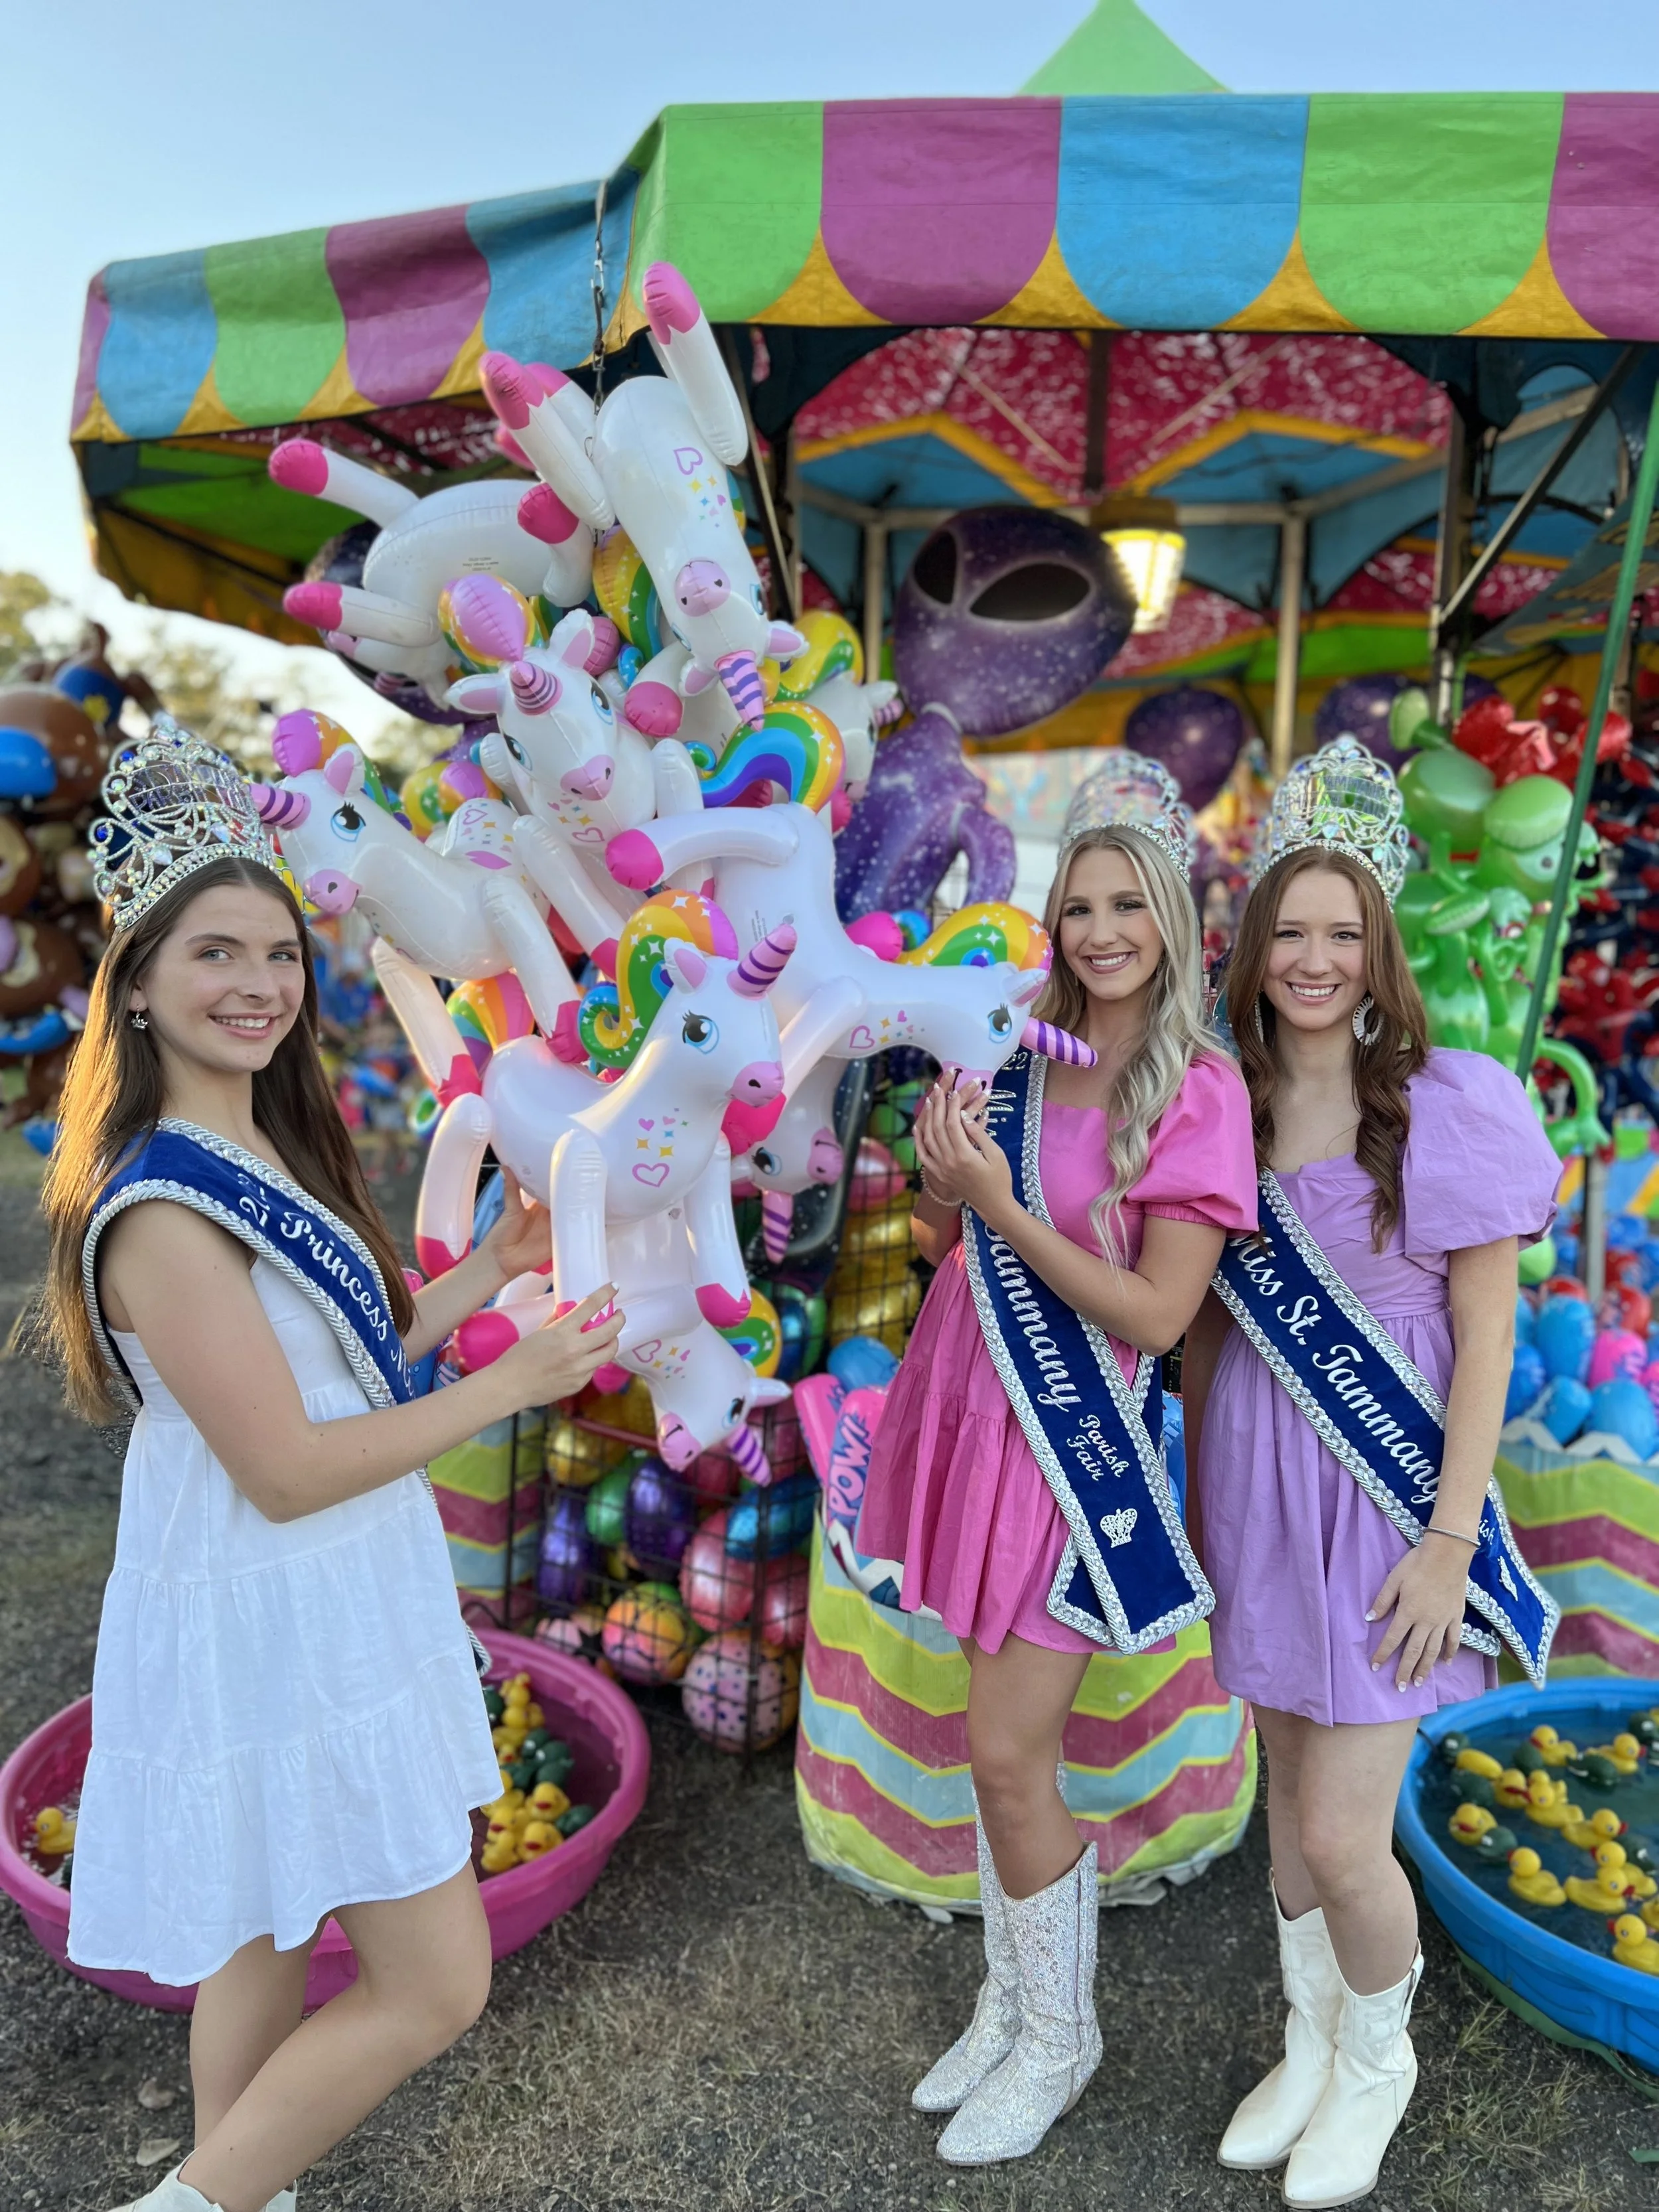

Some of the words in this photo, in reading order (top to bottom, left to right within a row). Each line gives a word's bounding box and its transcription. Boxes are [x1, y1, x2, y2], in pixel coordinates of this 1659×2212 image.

[1001, 1051, 1028, 1070] 22
[280, 1211, 388, 1342] Princess
[1276, 1295, 1322, 1345] St.
[1312, 1344, 1441, 1504] Tammany
[1066, 1434, 1104, 1481] Fair
[1078, 1414, 1130, 1478] Parish
[1479, 1518, 1495, 1545] ish
